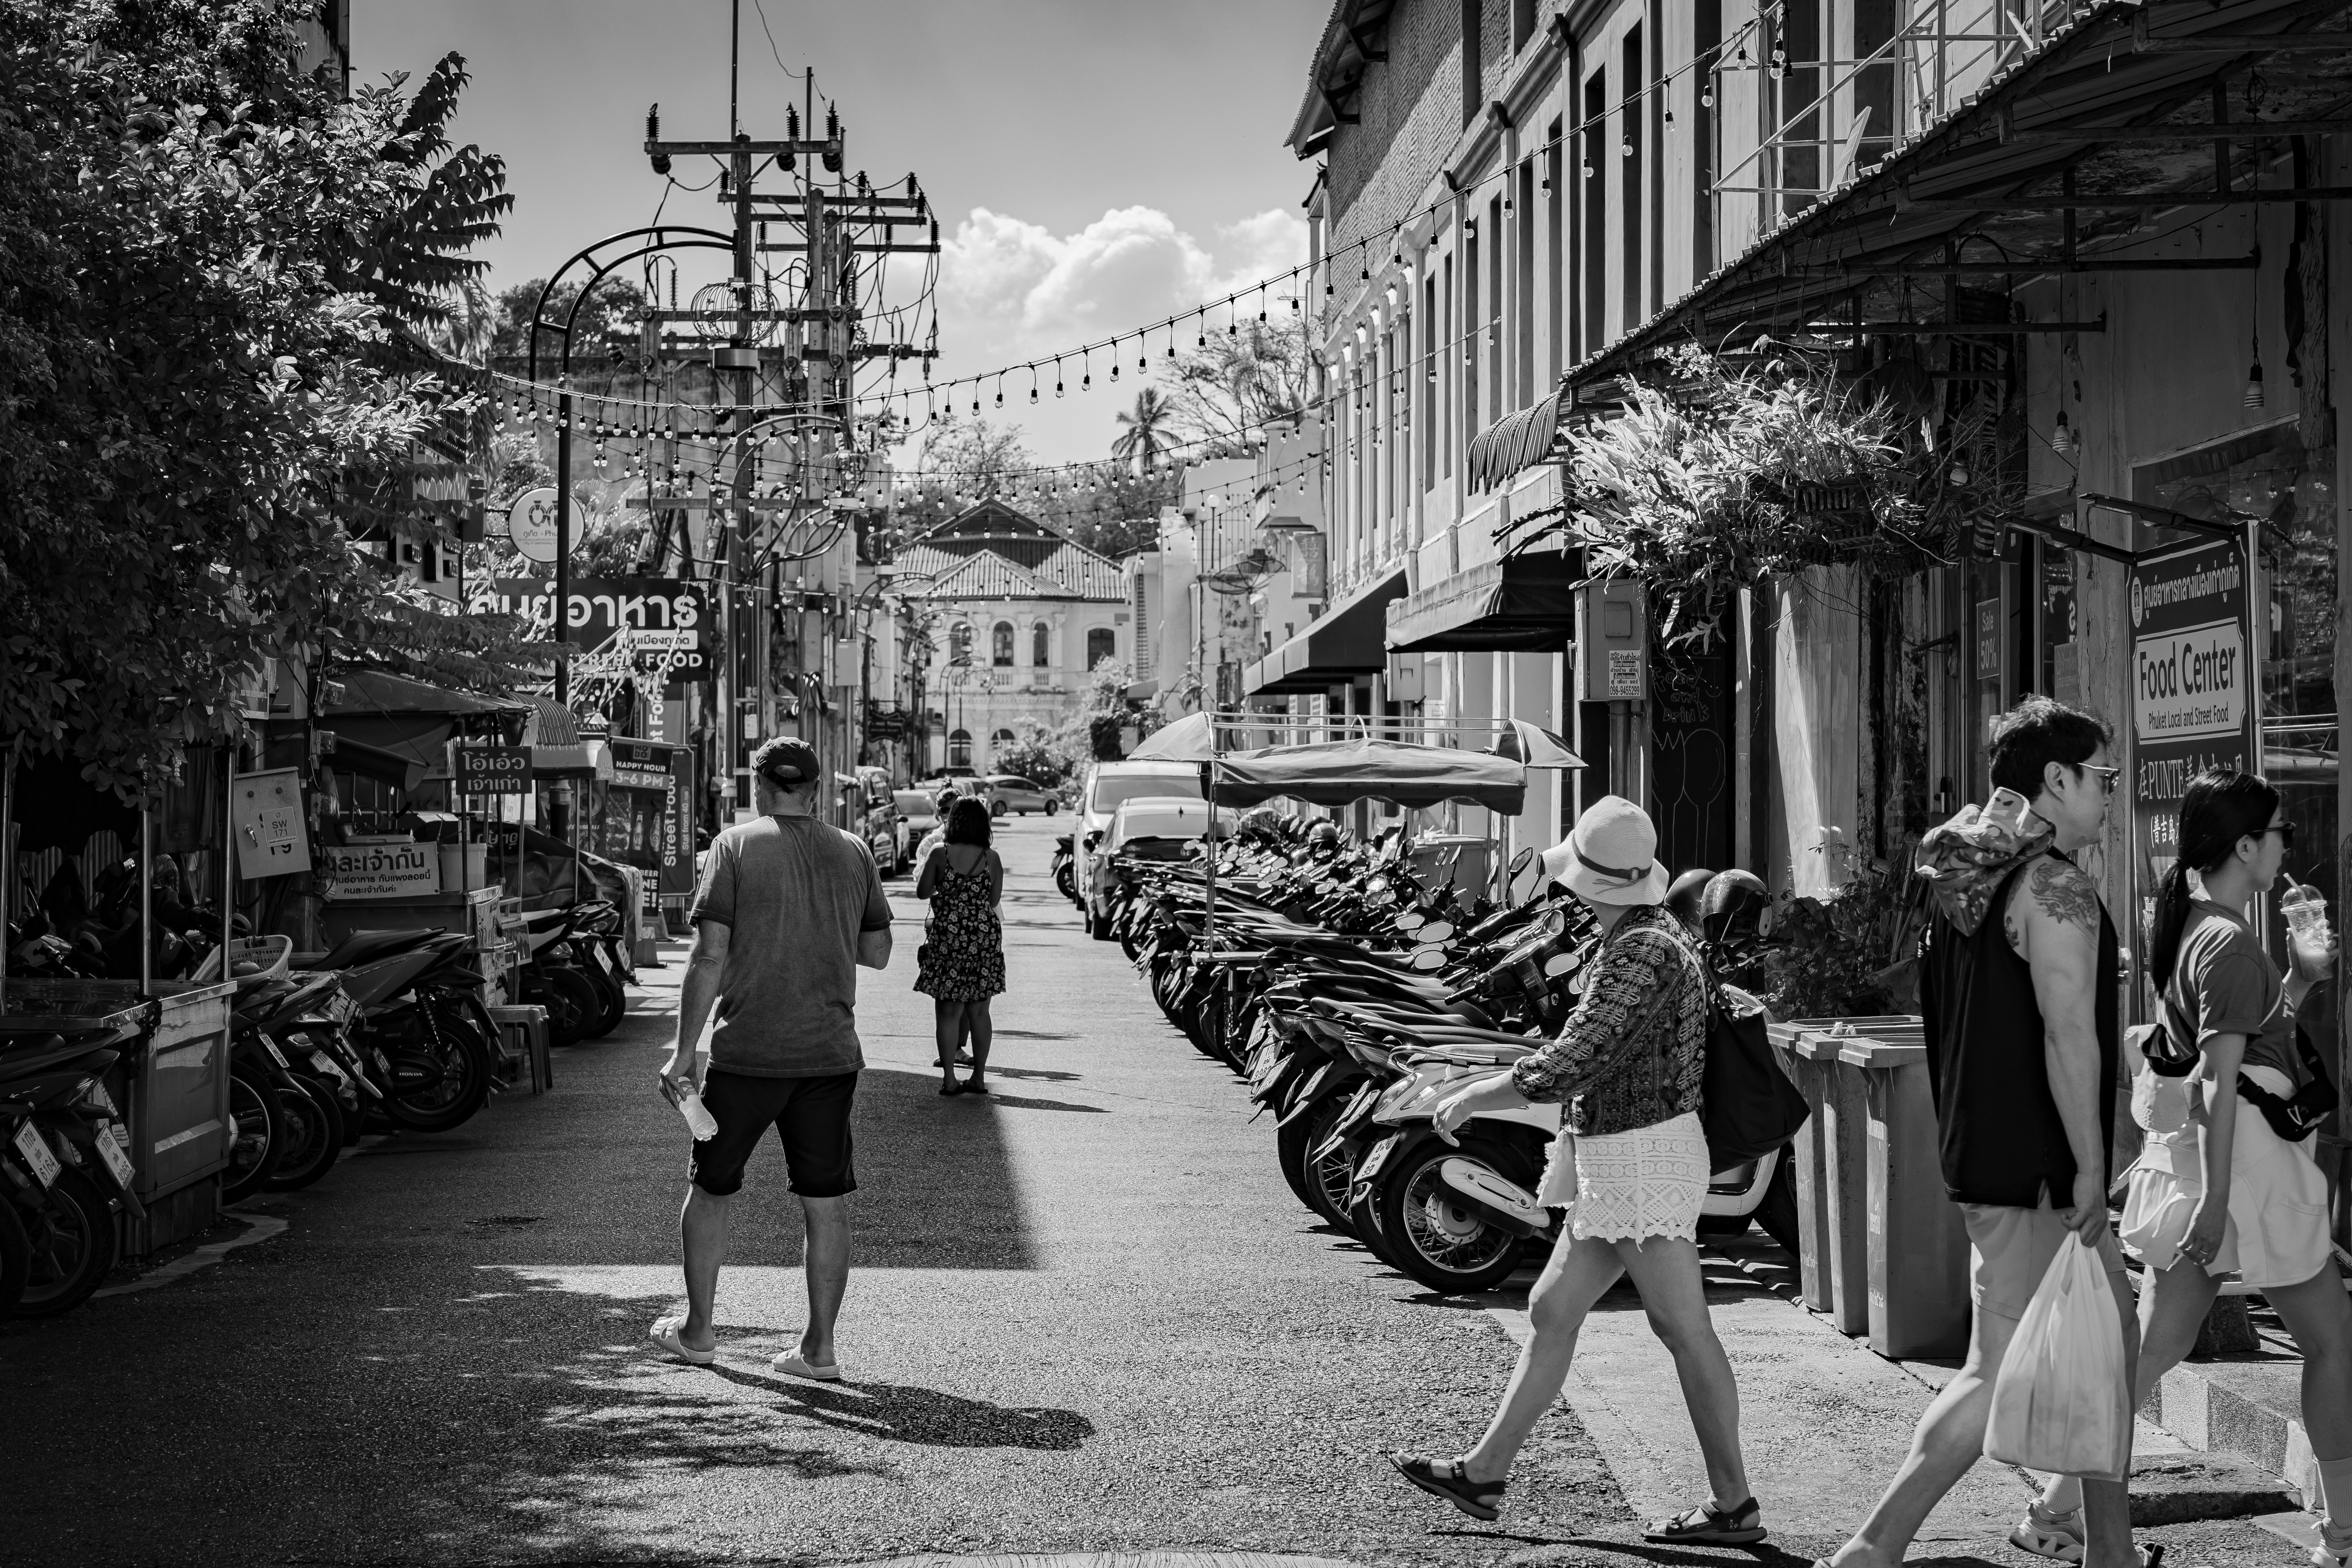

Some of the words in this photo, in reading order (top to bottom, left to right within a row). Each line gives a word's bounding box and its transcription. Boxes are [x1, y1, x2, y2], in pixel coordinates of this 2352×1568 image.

[1982, 610, 1993, 632] Sale
[646, 653, 702, 667] FOOD
[1981, 637, 1996, 670] 50%
[2140, 641, 2177, 700] Food
[2182, 639, 2236, 695] Center
[1610, 686, 1639, 695] 098-9455299
[1671, 687, 1700, 703] and
[2148, 710, 2167, 730] Phuket
[2168, 707, 2182, 728] Local
[2183, 706, 2194, 726] and
[2195, 705, 2212, 726] Street
[2213, 701, 2229, 723] Food
[462, 751, 525, 771] โอ้เอ๋ว
[616, 761, 642, 770] HAPPY
[643, 763, 666, 773] HOUR
[468, 774, 520, 791] เจ้าเก่า
[616, 772, 638, 785] 3-6
[642, 774, 664, 787] PM
[272, 820, 287, 829] SW
[274, 828, 288, 837] 171
[664, 818, 677, 867] Street
[40, 1155, 56, 1181] 6164
[118, 1160, 132, 1182] 9265
